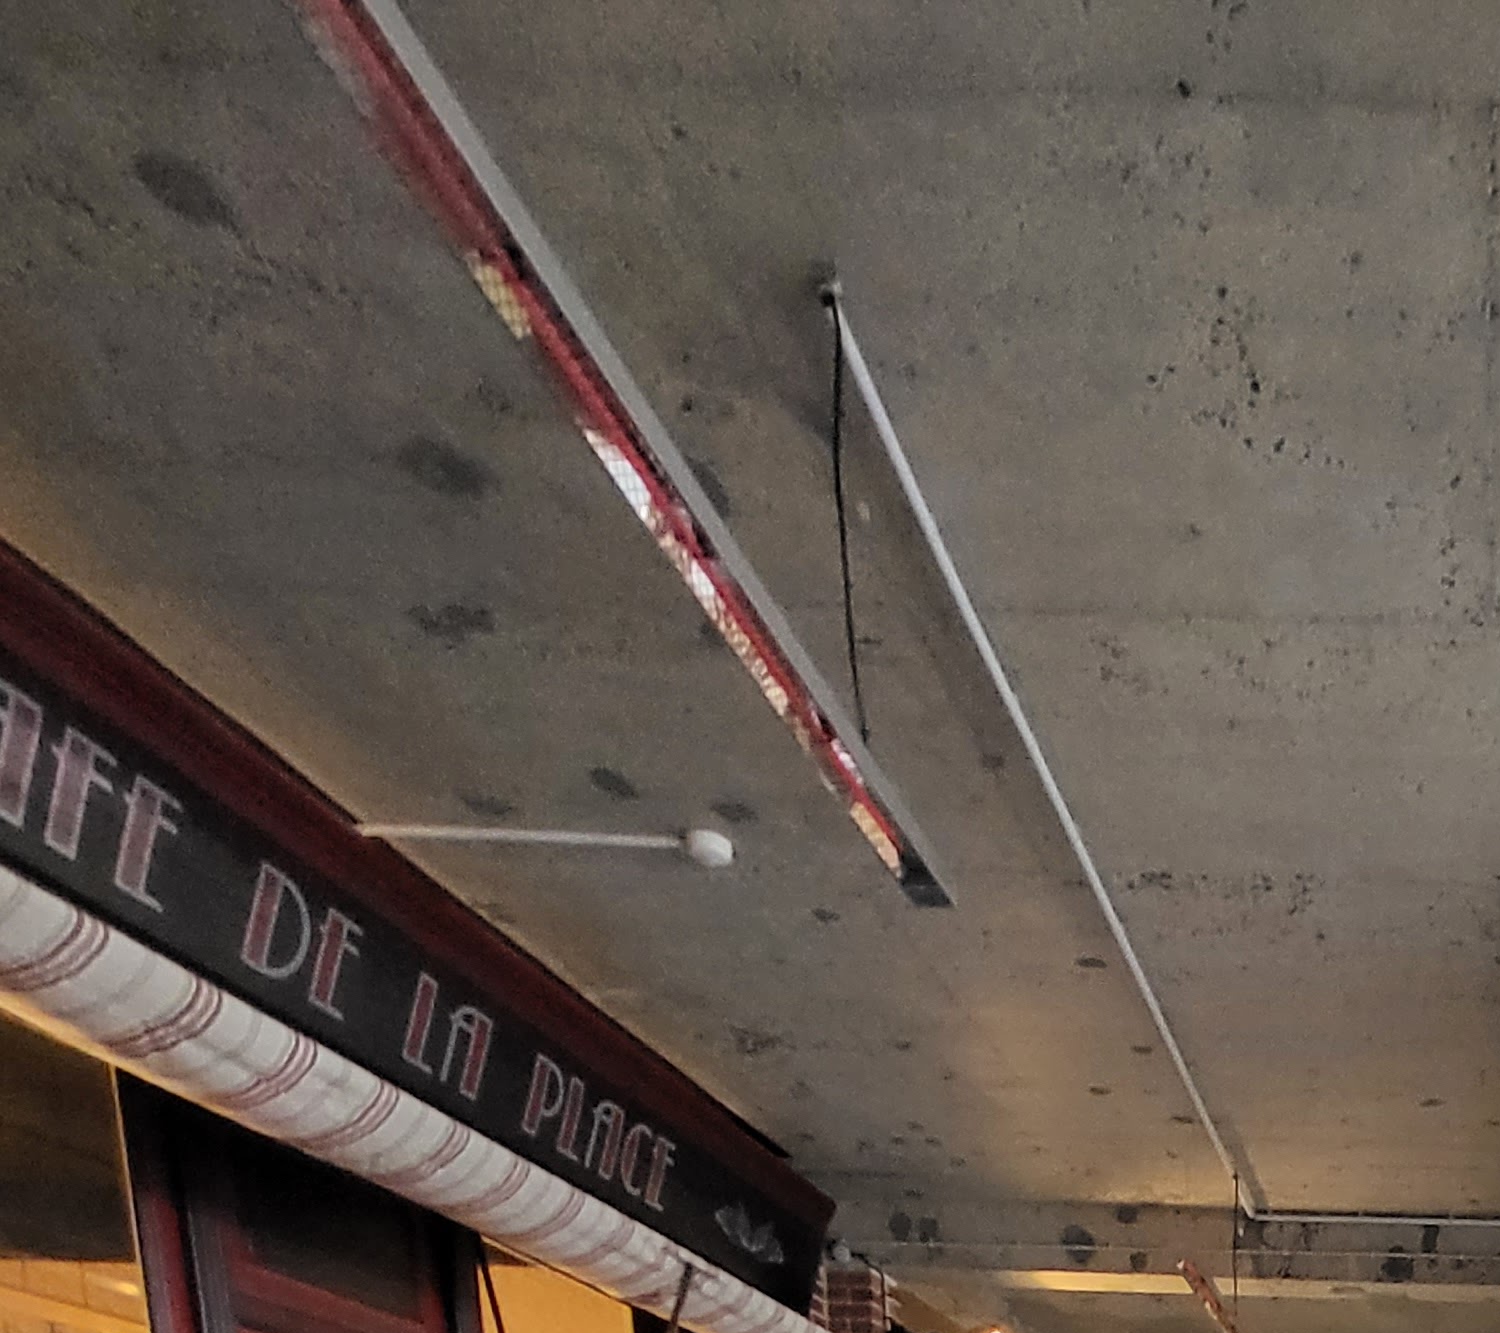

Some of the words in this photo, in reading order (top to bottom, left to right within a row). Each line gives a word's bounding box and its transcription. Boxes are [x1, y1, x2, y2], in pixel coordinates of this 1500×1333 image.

[240, 863, 365, 1020] DE
[402, 972, 493, 1101] LA
[521, 1053, 677, 1212] PLACE
